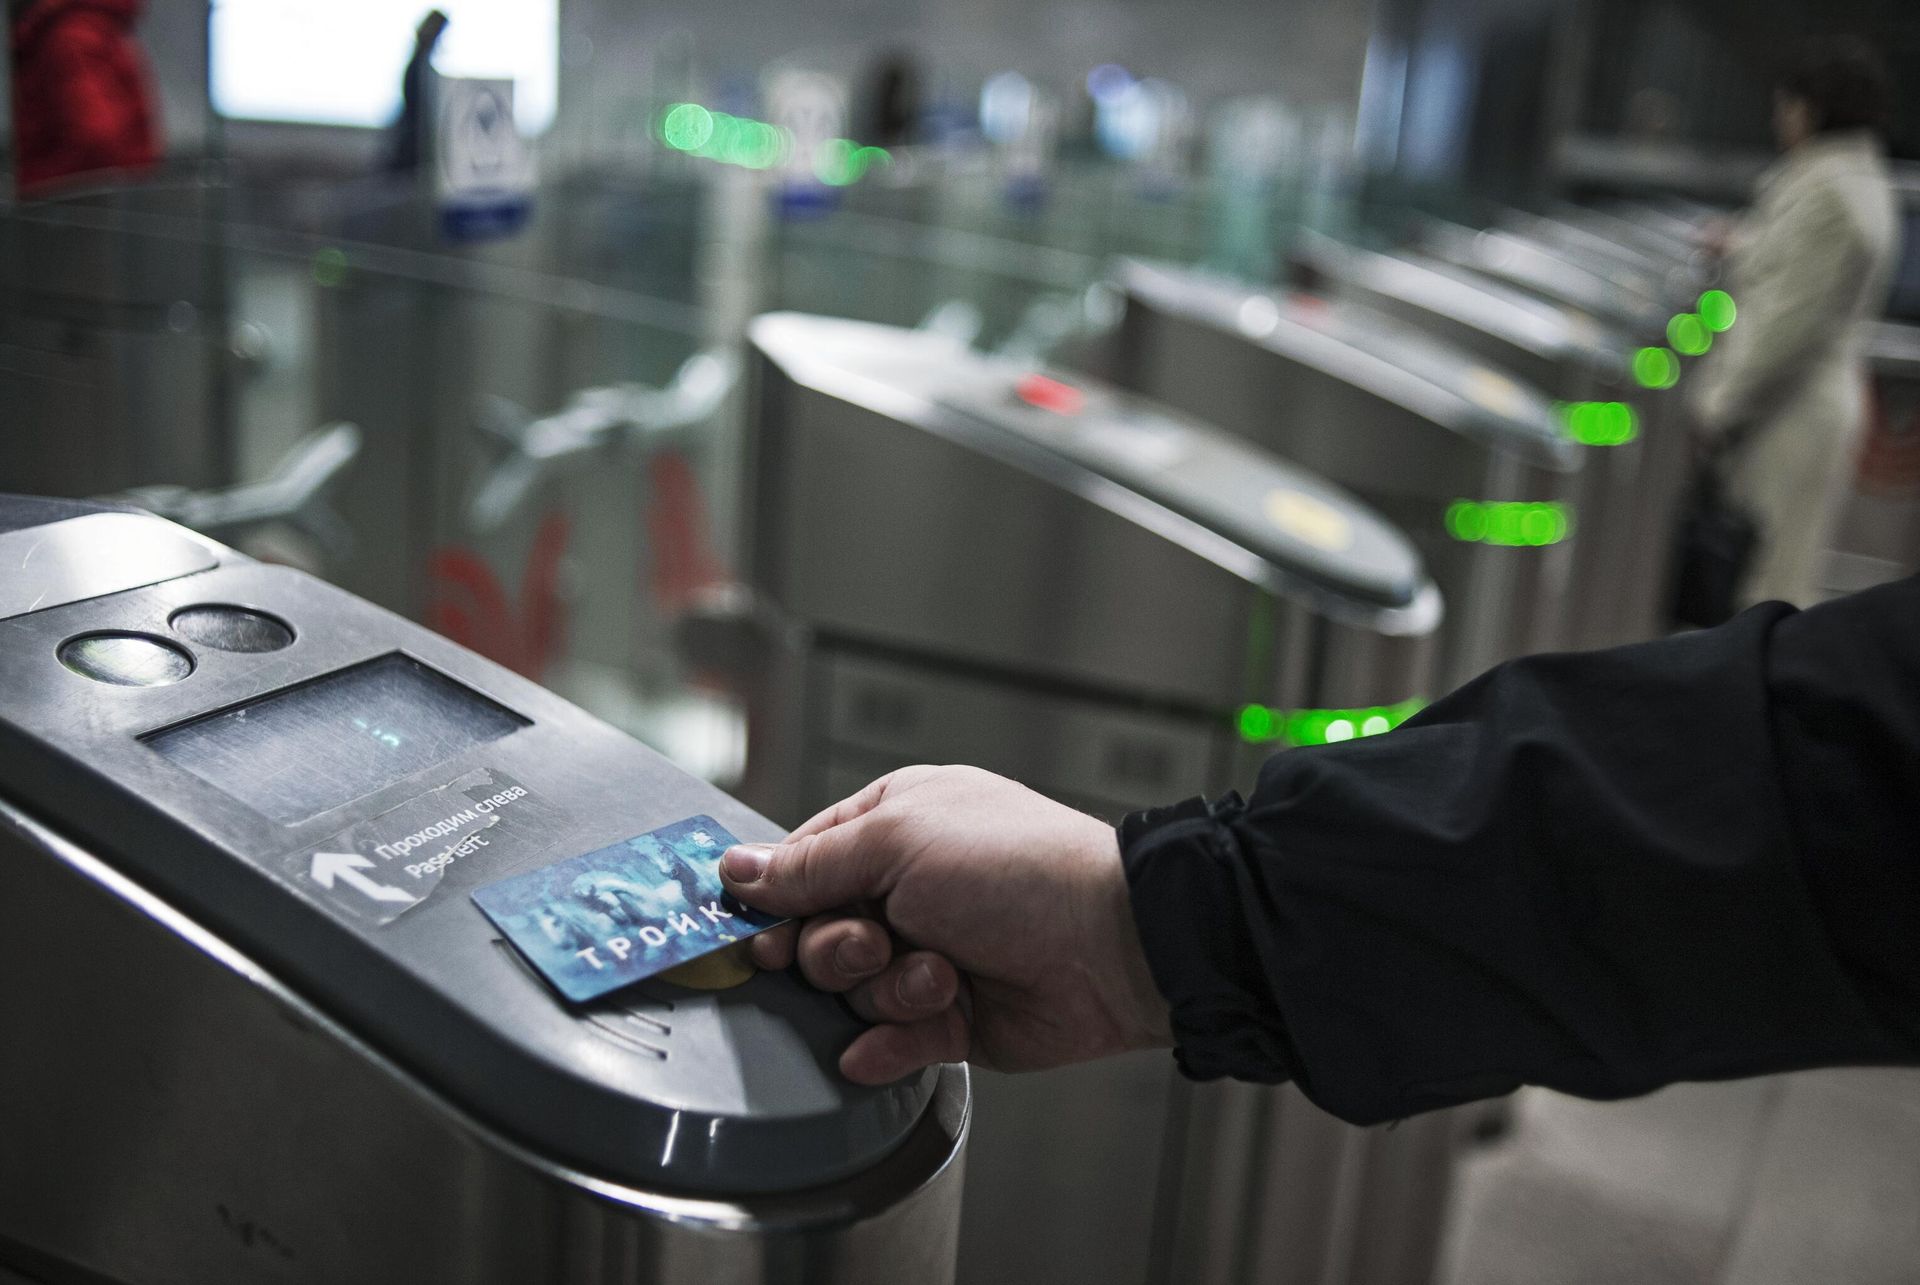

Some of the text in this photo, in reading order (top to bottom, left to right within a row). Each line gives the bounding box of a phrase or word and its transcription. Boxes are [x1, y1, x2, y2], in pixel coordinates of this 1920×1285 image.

[374, 785, 528, 860] Проходим слева
[575, 901, 747, 970] ТРОЙК
